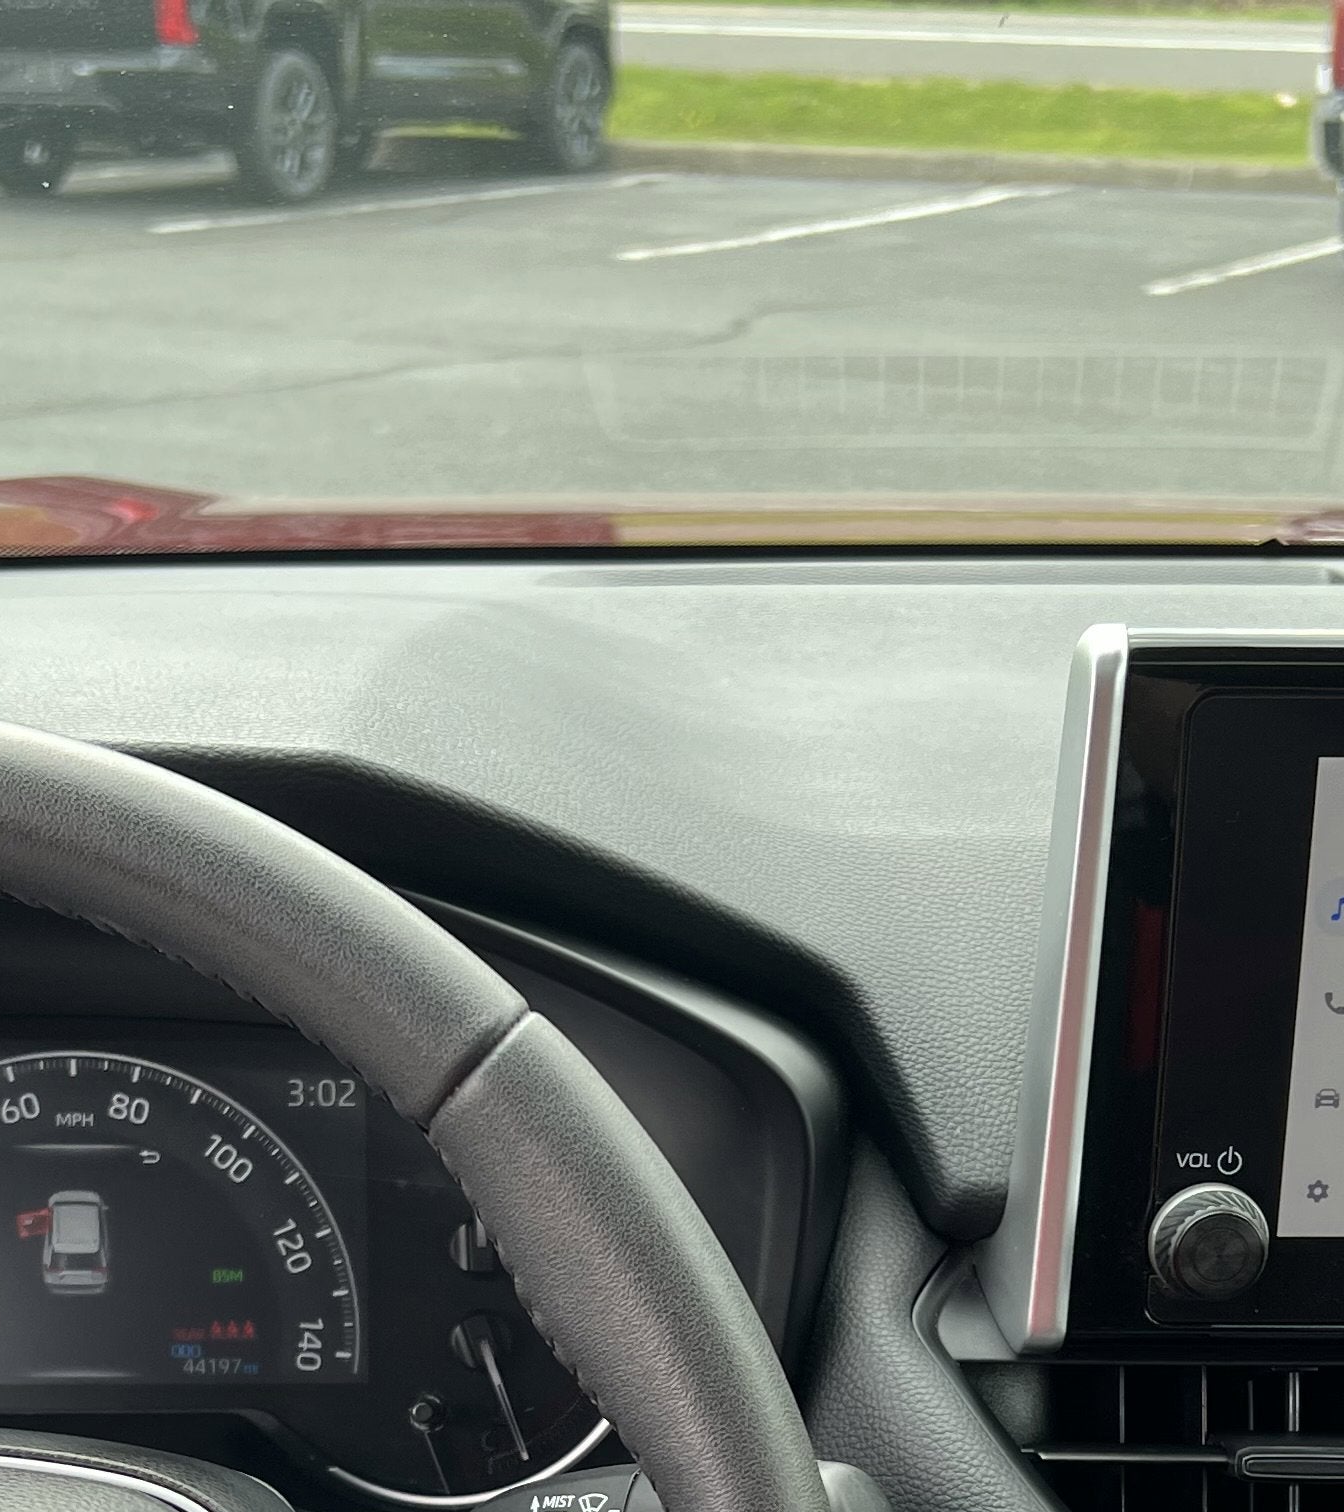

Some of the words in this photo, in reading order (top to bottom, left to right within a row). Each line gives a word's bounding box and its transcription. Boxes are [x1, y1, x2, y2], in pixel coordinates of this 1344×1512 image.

[288, 1079, 356, 1106] 3:02
[1, 1093, 40, 1123] 60
[56, 1113, 93, 1127] MPH
[109, 1093, 149, 1124] 80
[203, 1134, 253, 1184] 100
[1177, 1153, 1211, 1167] VOL
[273, 1219, 311, 1273] 120
[296, 1319, 323, 1370] 140
[183, 1358, 242, 1375] 44197
[543, 1495, 575, 1508] MIST
